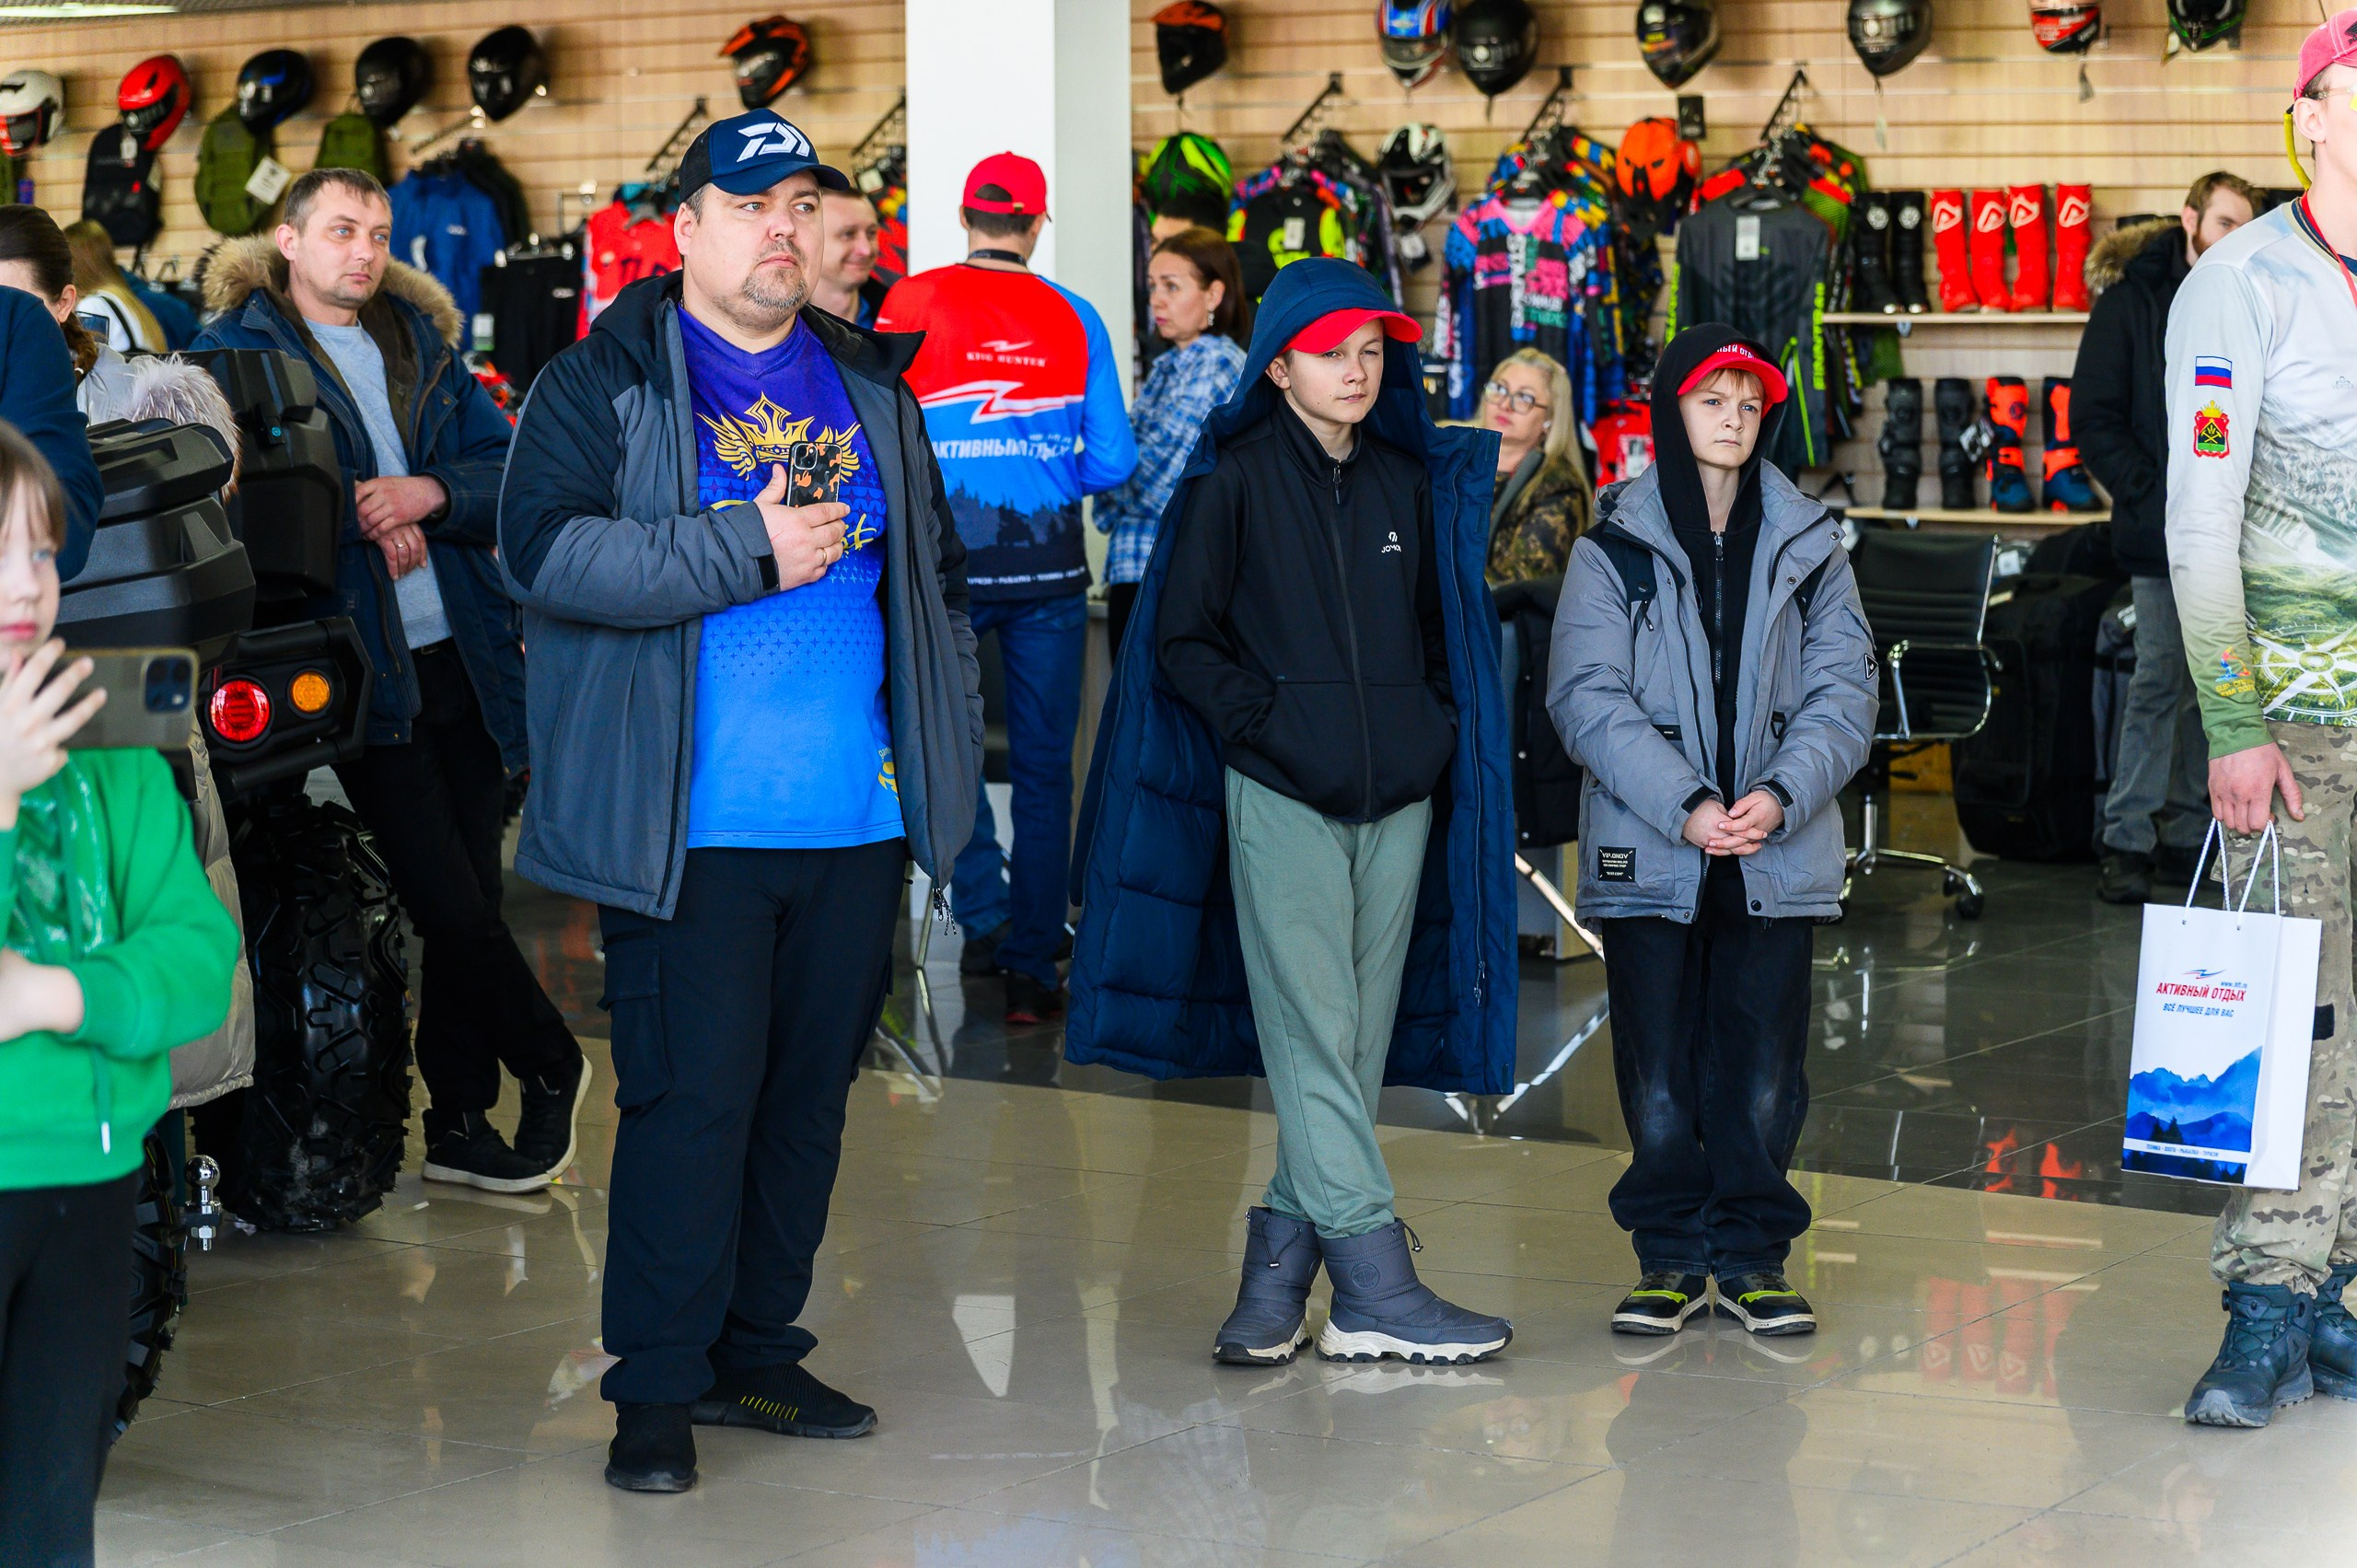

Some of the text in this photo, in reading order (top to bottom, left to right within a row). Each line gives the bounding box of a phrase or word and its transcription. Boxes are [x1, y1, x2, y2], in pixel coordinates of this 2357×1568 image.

[2156, 982, 2247, 1002] АКТИВНЫЙ ОТДЫХ
[2177, 1005, 2203, 1015] ЛУЧШЕЕ
[2204, 1007, 2220, 1016] ДЛЯ
[2221, 1009, 2235, 1017] ВАС
